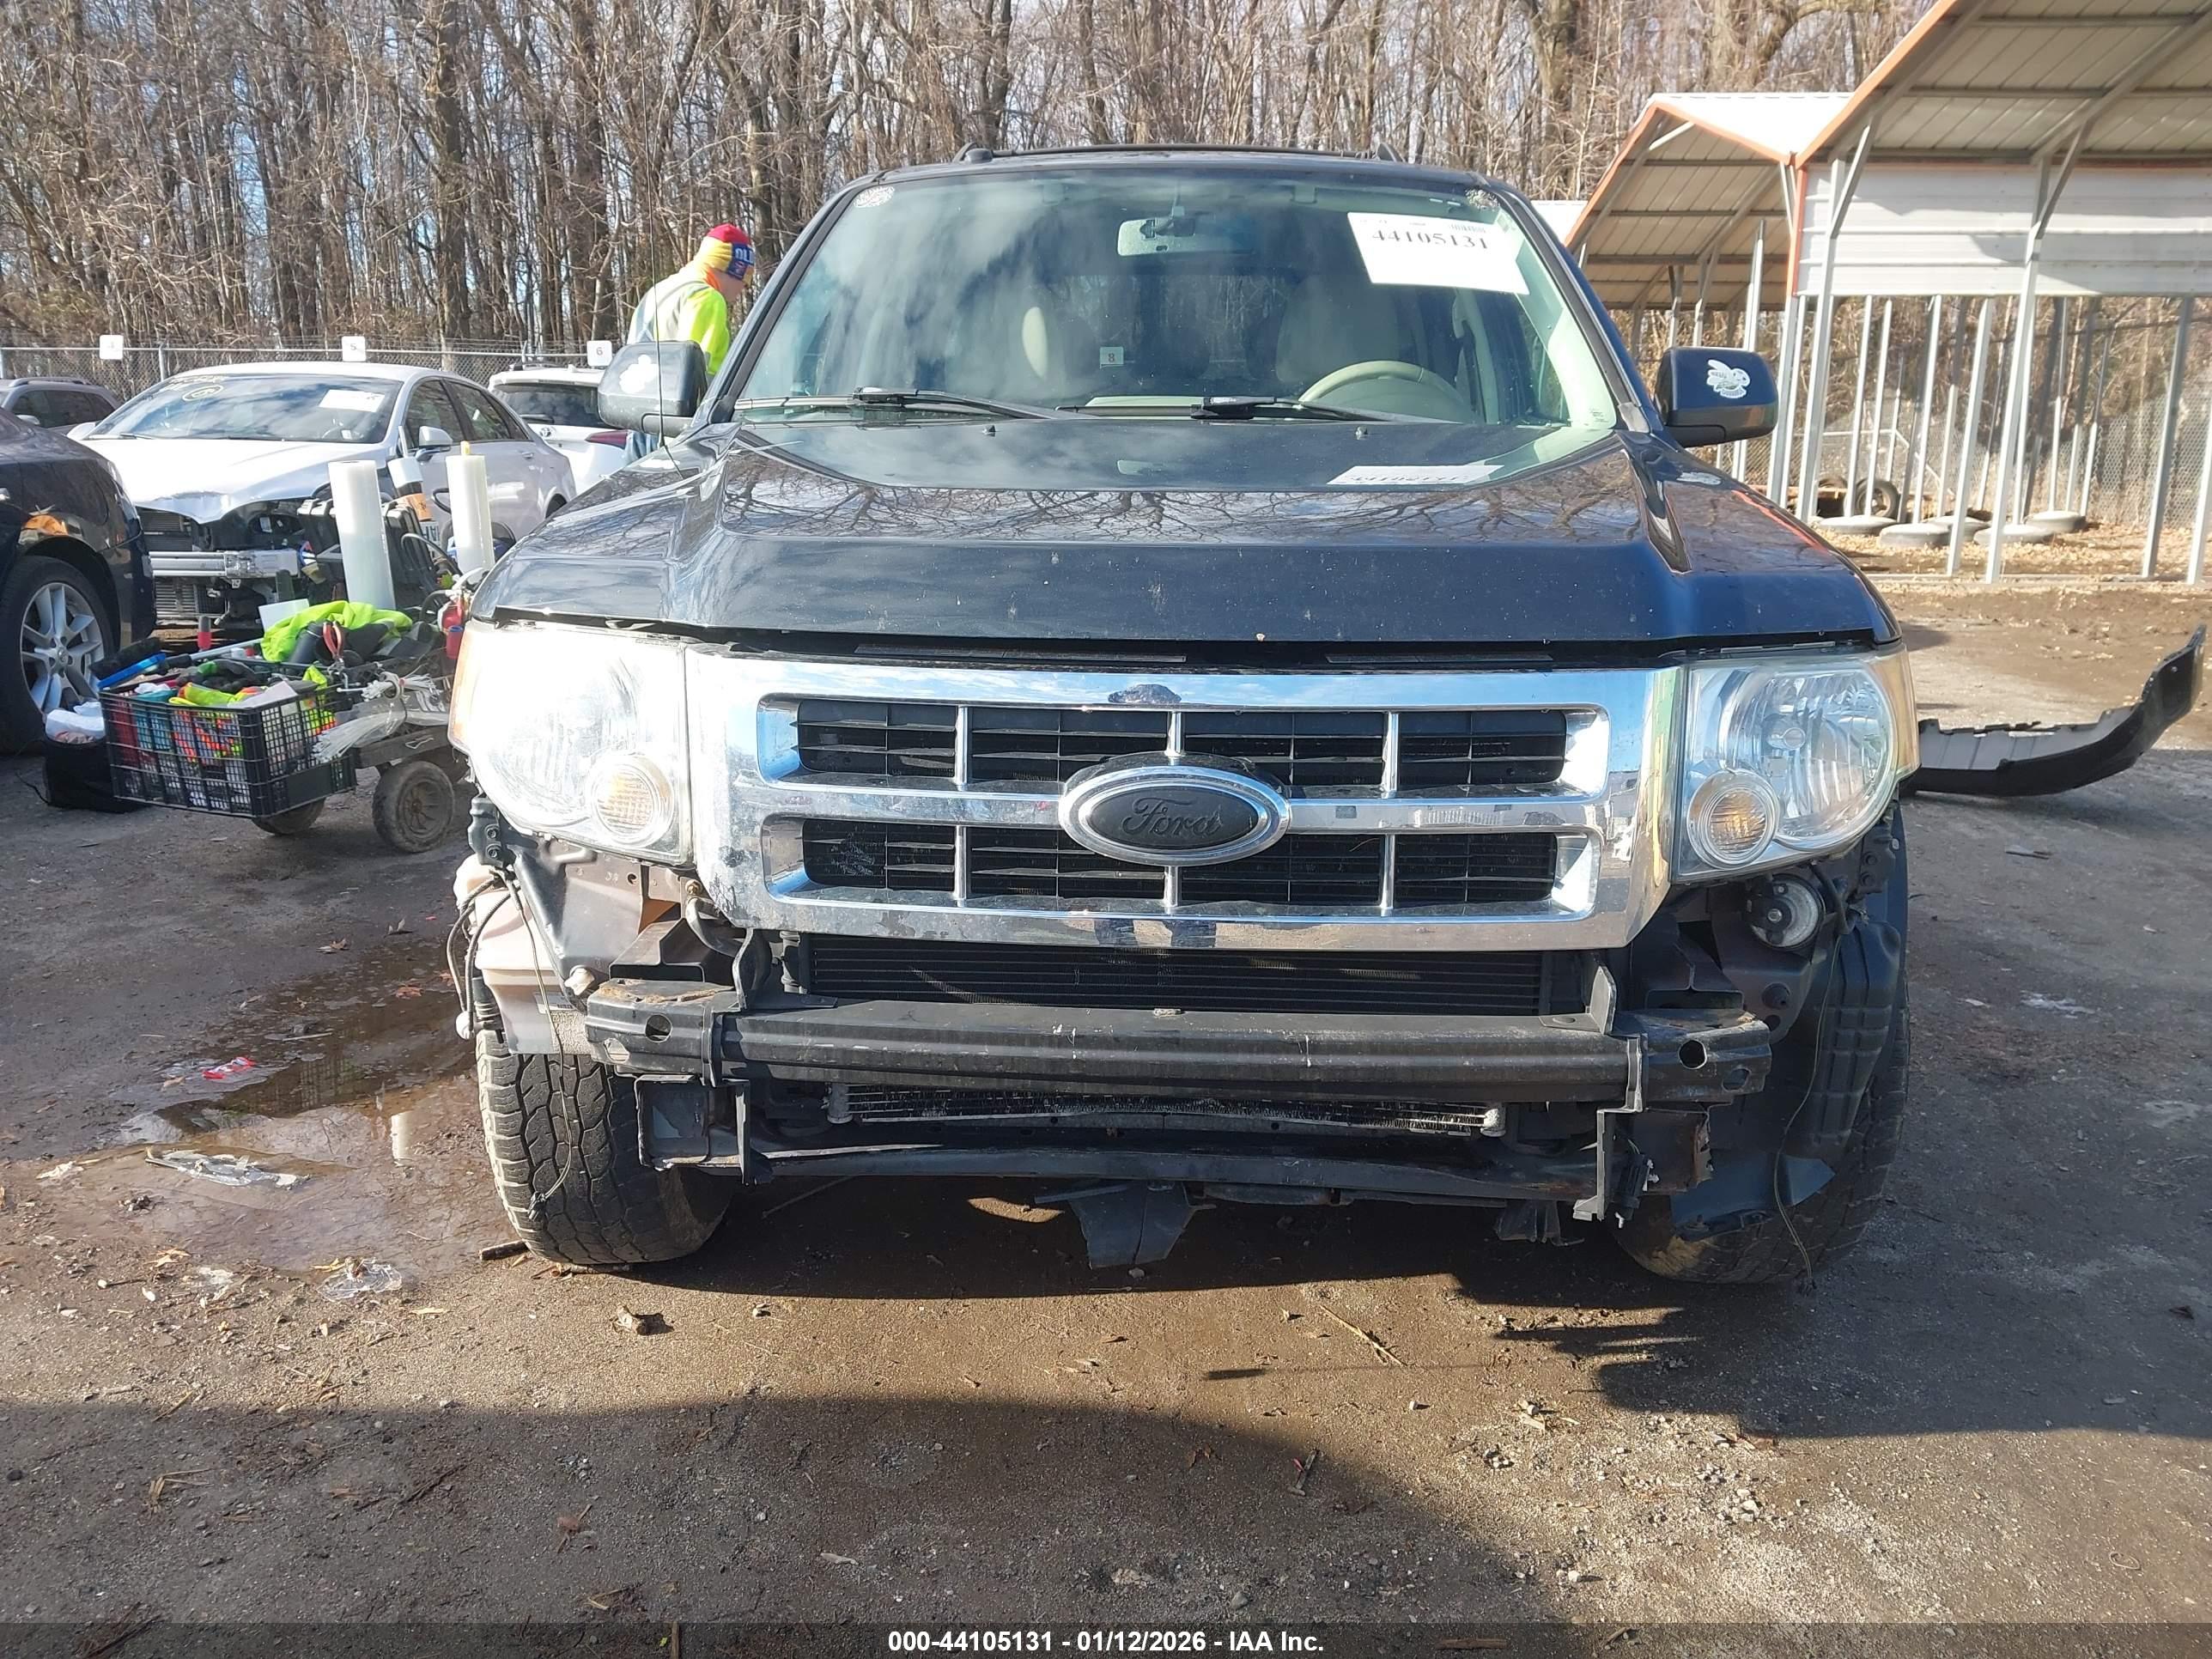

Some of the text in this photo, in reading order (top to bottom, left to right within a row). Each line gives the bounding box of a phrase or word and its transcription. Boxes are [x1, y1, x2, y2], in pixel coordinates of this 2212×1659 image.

[1372, 230, 1488, 249] 44105131
[349, 343, 357, 351] 5
[596, 346, 604, 356] 6
[1108, 352, 1115, 362] 8
[1121, 797, 1223, 836] Ford
